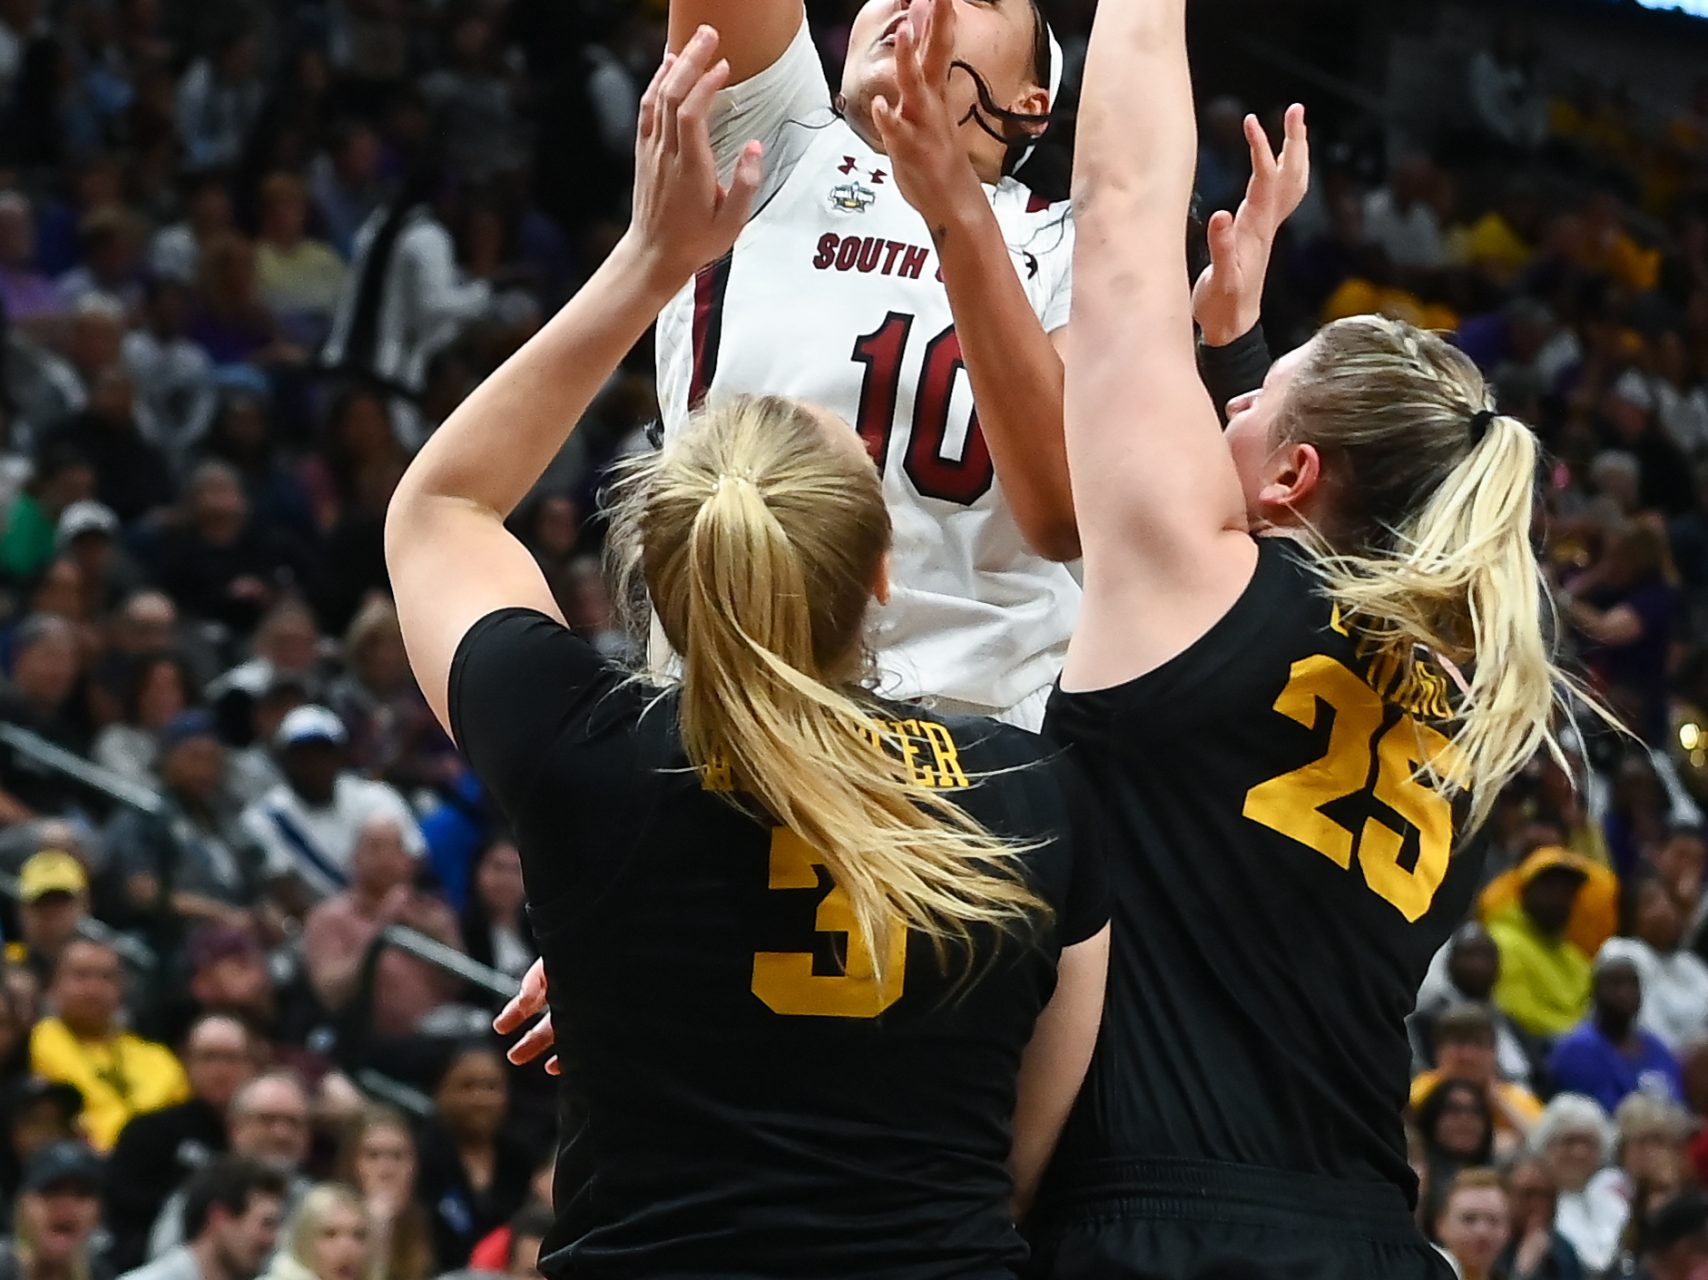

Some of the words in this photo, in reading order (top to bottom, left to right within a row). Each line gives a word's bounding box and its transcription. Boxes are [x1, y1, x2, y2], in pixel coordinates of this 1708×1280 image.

[812, 232, 929, 280] SOUTH
[850, 310, 996, 507] 10
[1242, 653, 1471, 924] 25
[751, 825, 908, 1019] 3
